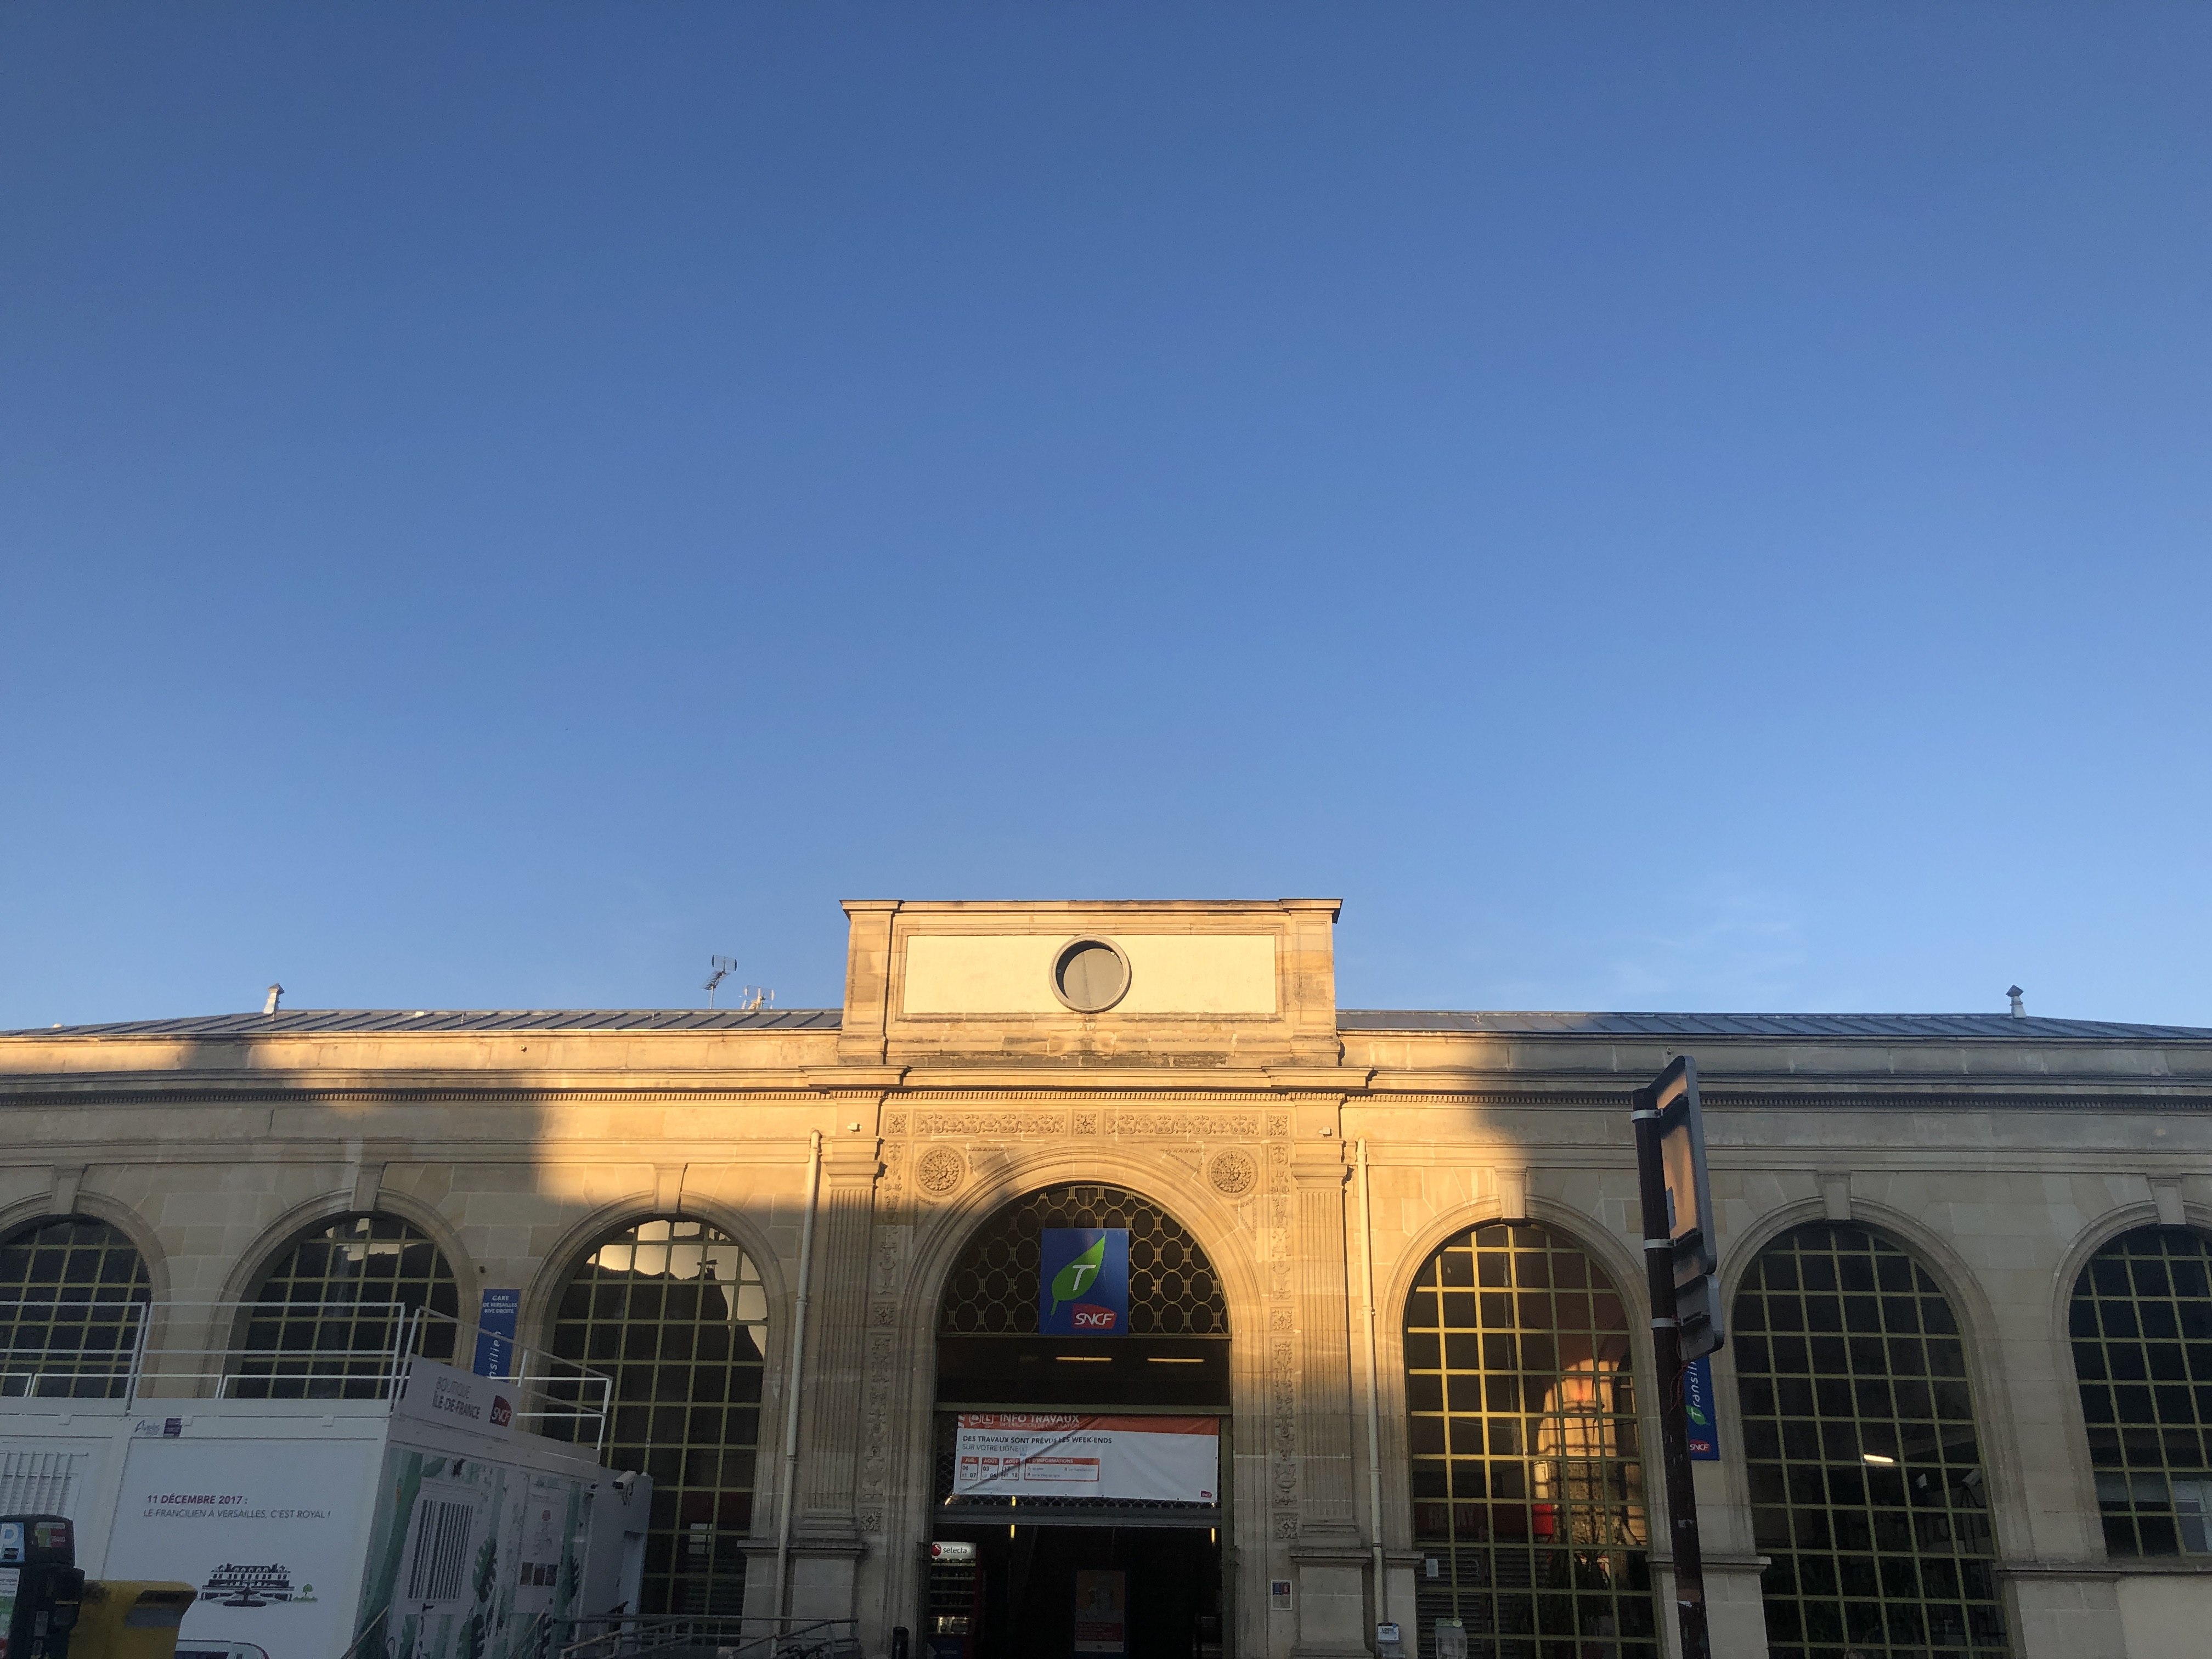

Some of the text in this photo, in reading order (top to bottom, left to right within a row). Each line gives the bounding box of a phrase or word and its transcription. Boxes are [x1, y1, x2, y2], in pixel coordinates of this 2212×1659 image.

[1072, 1264, 1097, 1291] T
[1074, 1313, 1115, 1325] SNCF
[488, 1331, 501, 1379] nsilien
[1688, 1362, 1702, 1419] Transili
[491, 1406, 512, 1423] SNCF
[1000, 1413, 1080, 1423] INFO TRAVAUX
[147, 1495, 157, 1503] 11
[160, 1493, 216, 1504] DÉCEMBRE
[218, 1495, 243, 1503] 2017
[144, 1509, 153, 1517] LE
[155, 1509, 206, 1517] FRANCILIEN
[270, 1510, 295, 1518] C'EST
